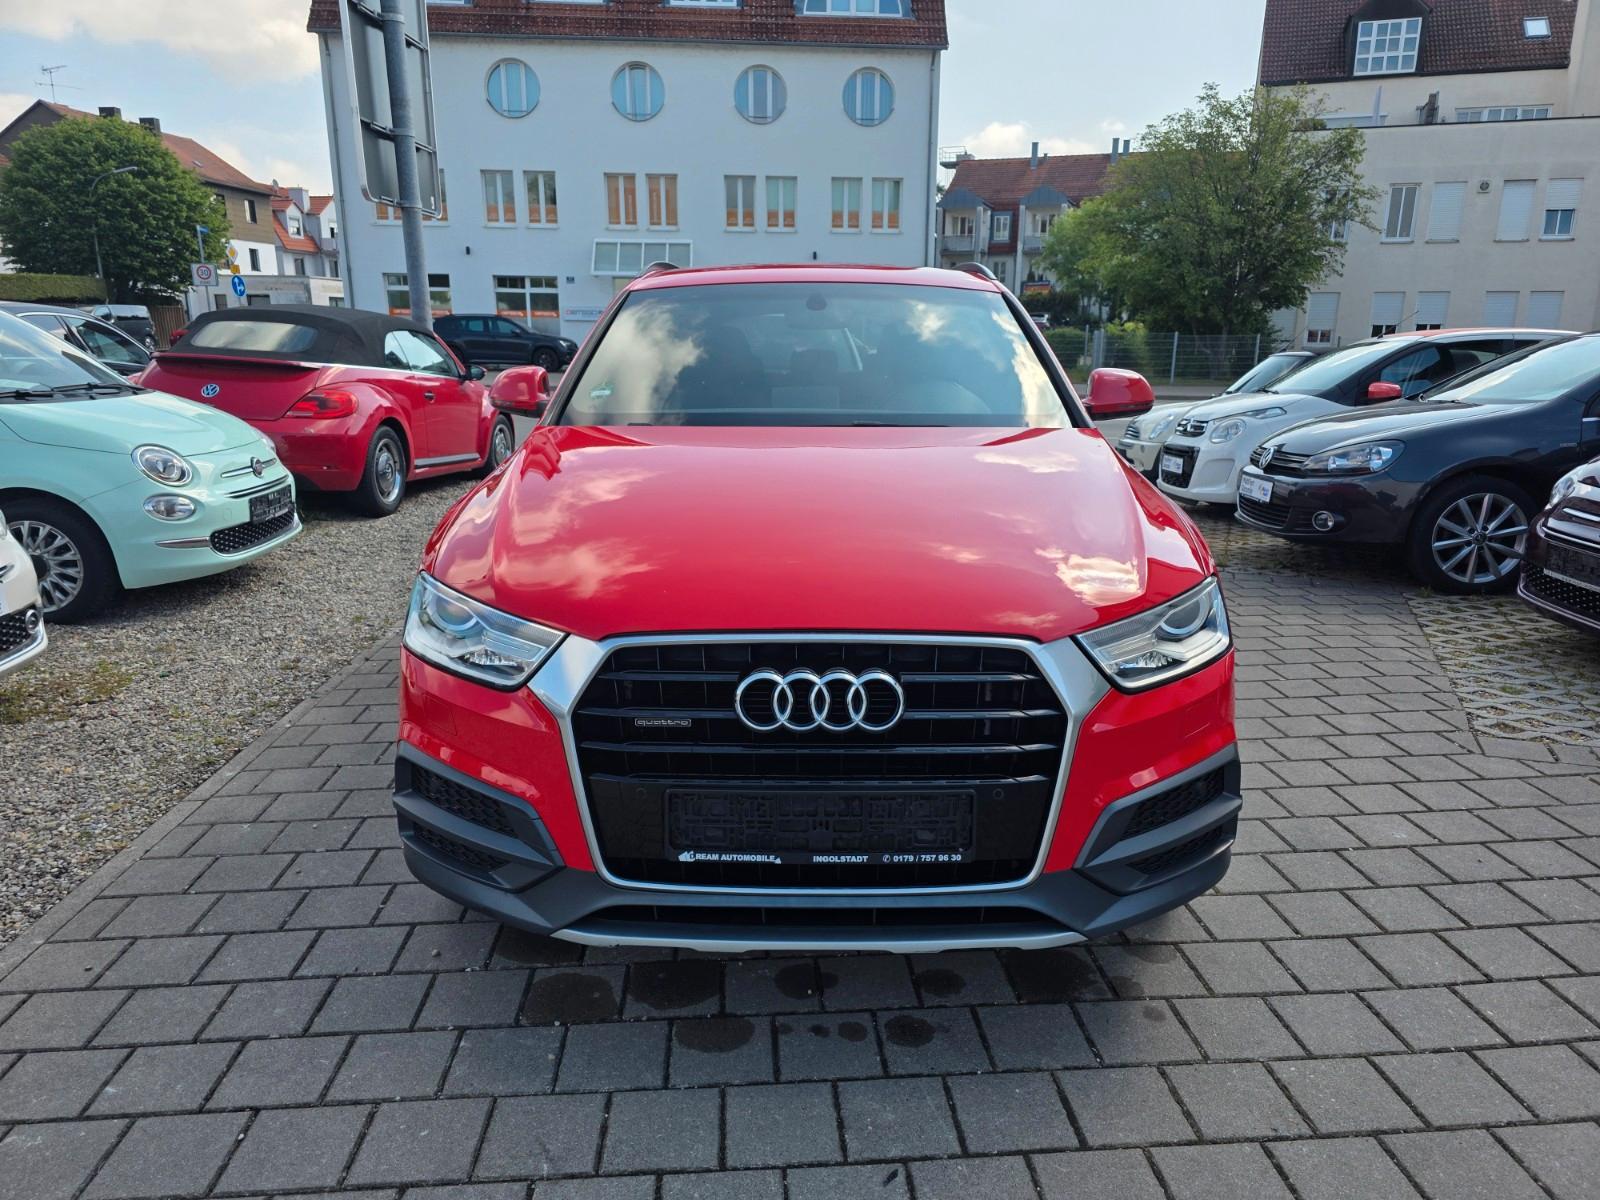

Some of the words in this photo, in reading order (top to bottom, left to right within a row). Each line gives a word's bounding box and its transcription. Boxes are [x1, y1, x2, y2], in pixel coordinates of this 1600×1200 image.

[636, 719, 689, 727] quattro
[813, 855, 868, 863] INGOLSTADT
[920, 854, 937, 862] 757
